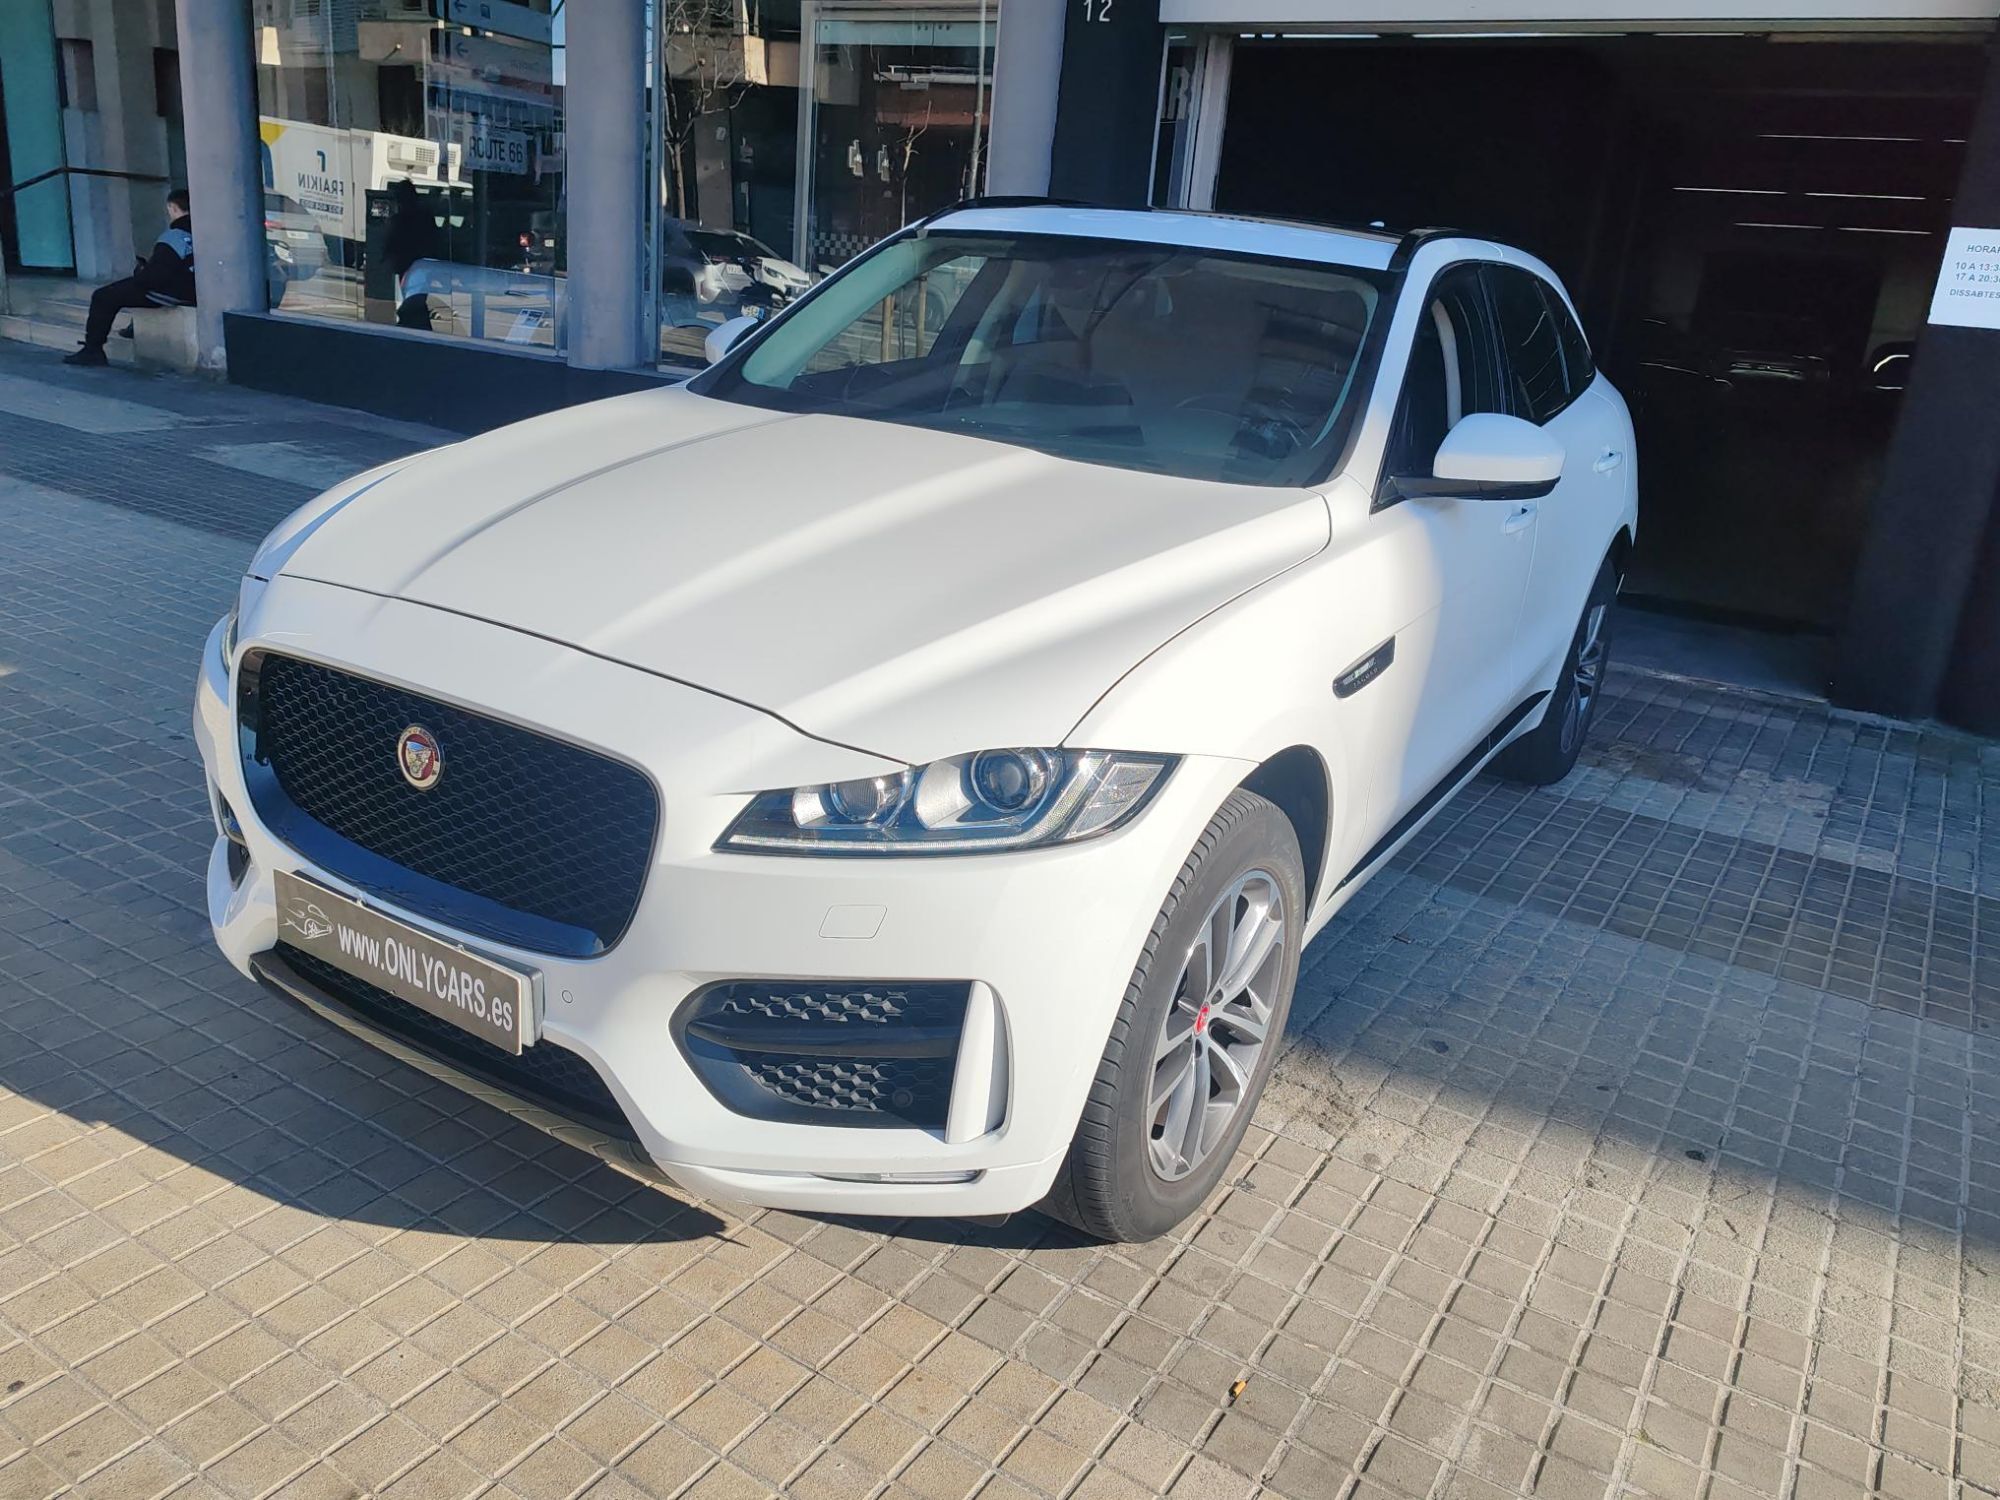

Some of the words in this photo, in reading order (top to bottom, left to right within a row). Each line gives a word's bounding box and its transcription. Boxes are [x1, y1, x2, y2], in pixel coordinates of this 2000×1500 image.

[1083, 0, 1112, 22] 12
[469, 136, 506, 161] ROUTE
[509, 142, 523, 163] 66
[1956, 262, 1967, 270] 10
[1968, 262, 1976, 270] A
[1979, 263, 2000, 272] 13:3
[1968, 273, 1976, 281] A
[337, 923, 513, 1032] www.ONLYCARS.es
